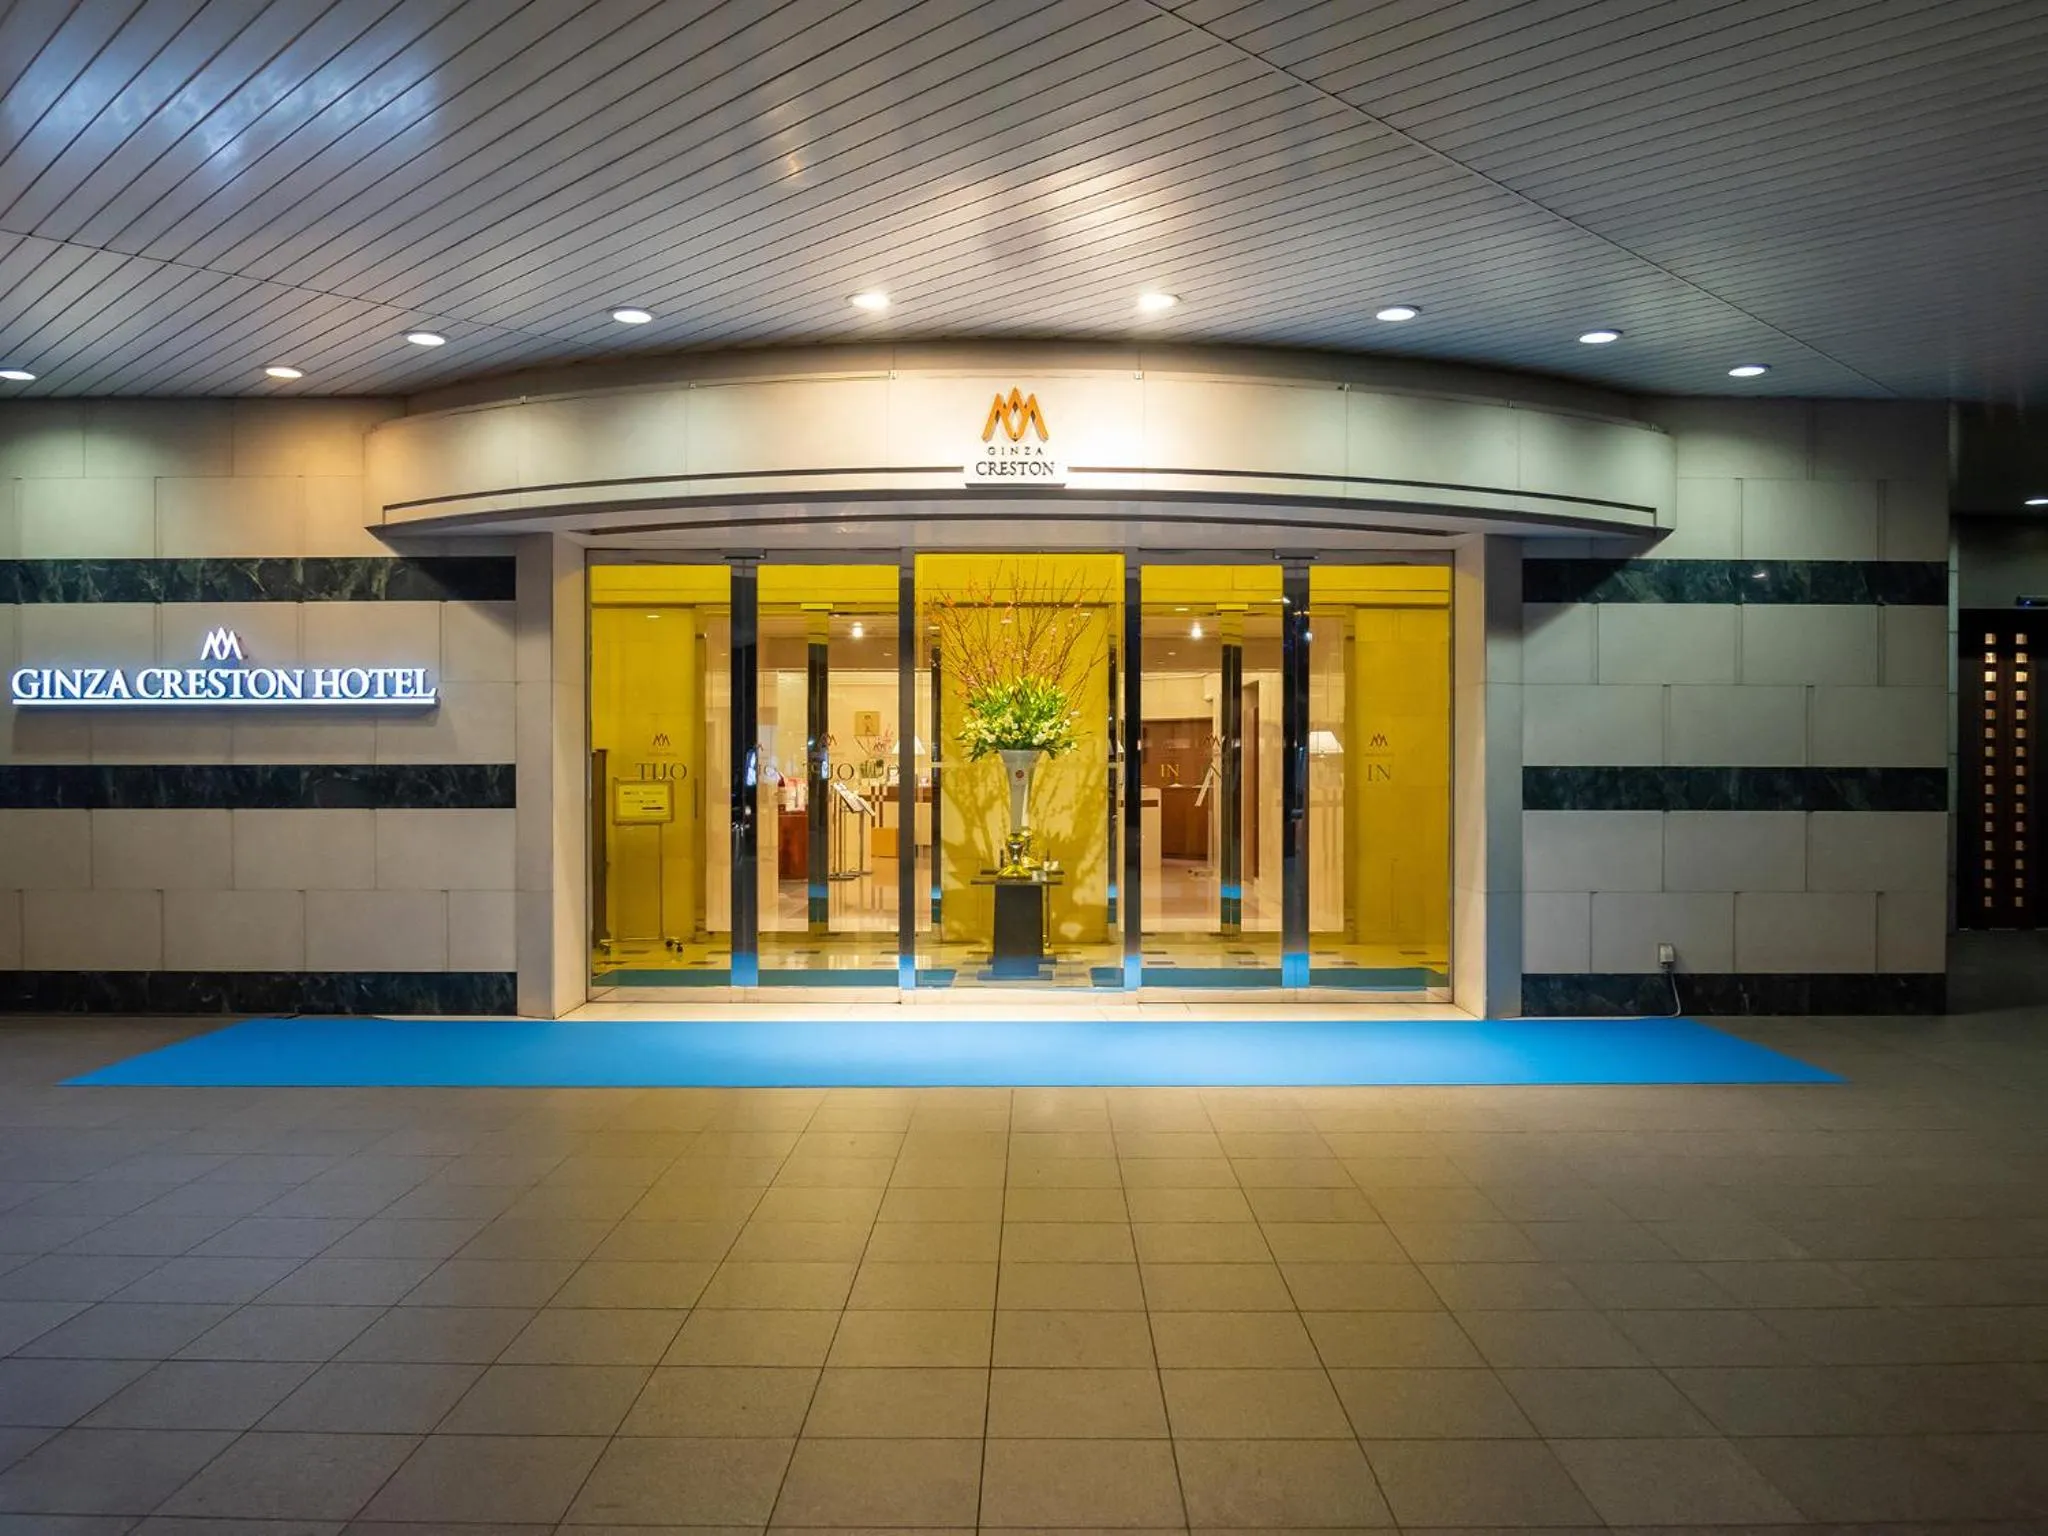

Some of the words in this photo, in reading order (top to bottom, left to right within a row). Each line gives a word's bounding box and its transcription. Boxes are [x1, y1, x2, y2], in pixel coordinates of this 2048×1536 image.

[987, 446, 1043, 456] GINZA
[975, 460, 1055, 476] CRESTON
[11, 668, 133, 699] GINZA
[136, 668, 304, 699] CRESTON
[312, 667, 437, 699] HOTEL
[1160, 763, 1181, 778] IN
[1366, 763, 1392, 782] IN
